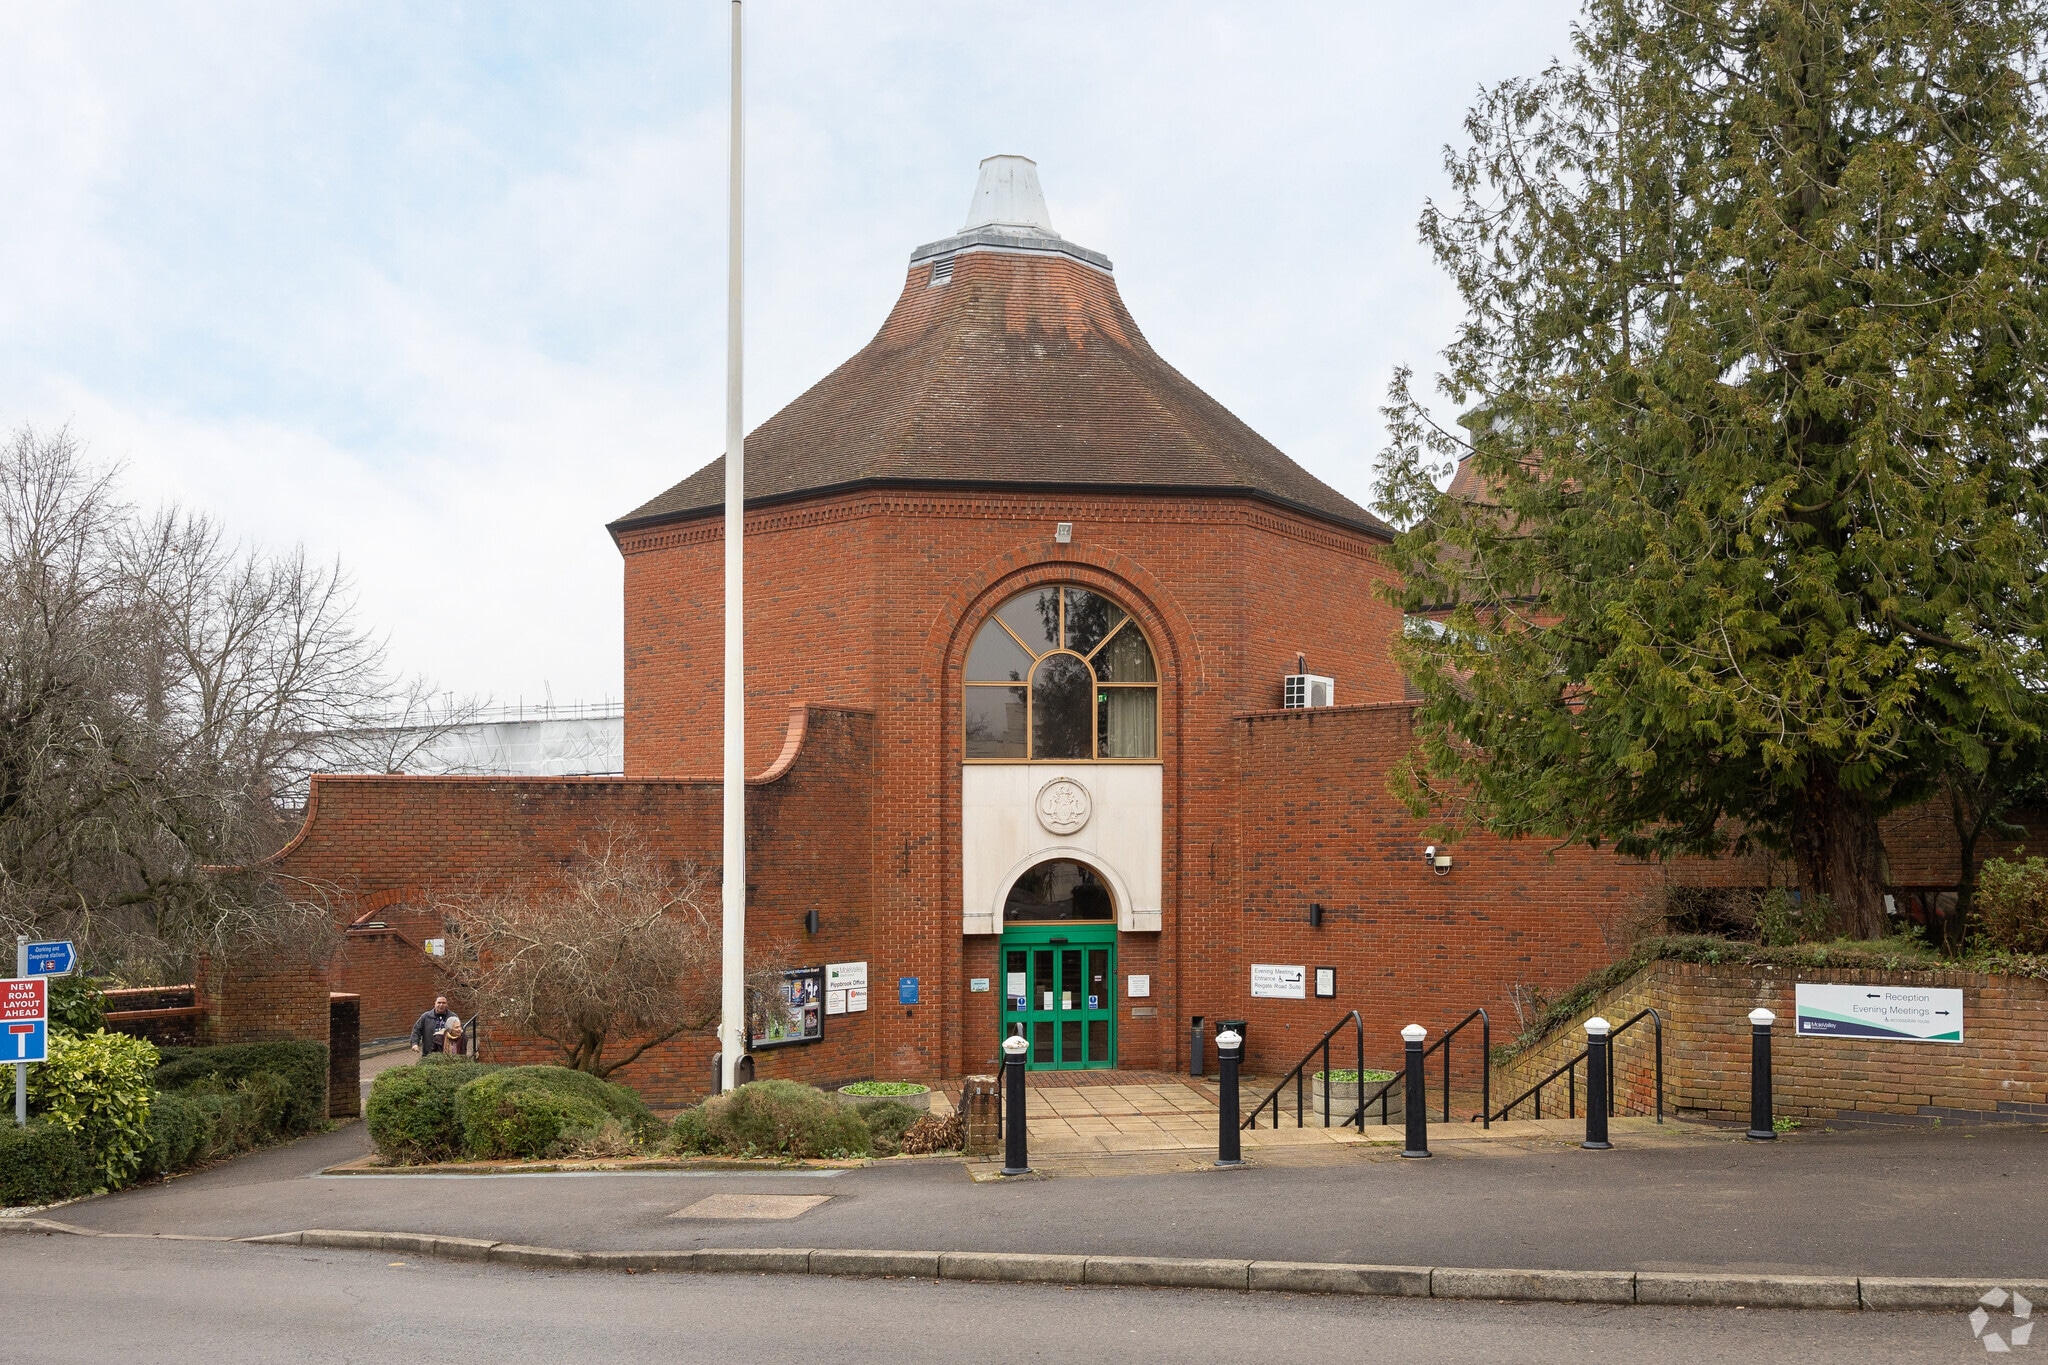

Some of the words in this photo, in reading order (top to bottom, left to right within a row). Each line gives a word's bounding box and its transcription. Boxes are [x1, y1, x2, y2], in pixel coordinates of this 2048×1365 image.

[1274, 968, 1294, 976] Meeting
[830, 980, 852, 988] Pippbrook
[1885, 993, 1930, 1002] Reception
[3, 1000, 40, 1008] LAYOUT
[5, 1009, 39, 1017] AHEAD
[1853, 1004, 1888, 1016] Evening
[1889, 1006, 1930, 1016] Meetings
[1811, 1021, 1837, 1029] MoleValley
